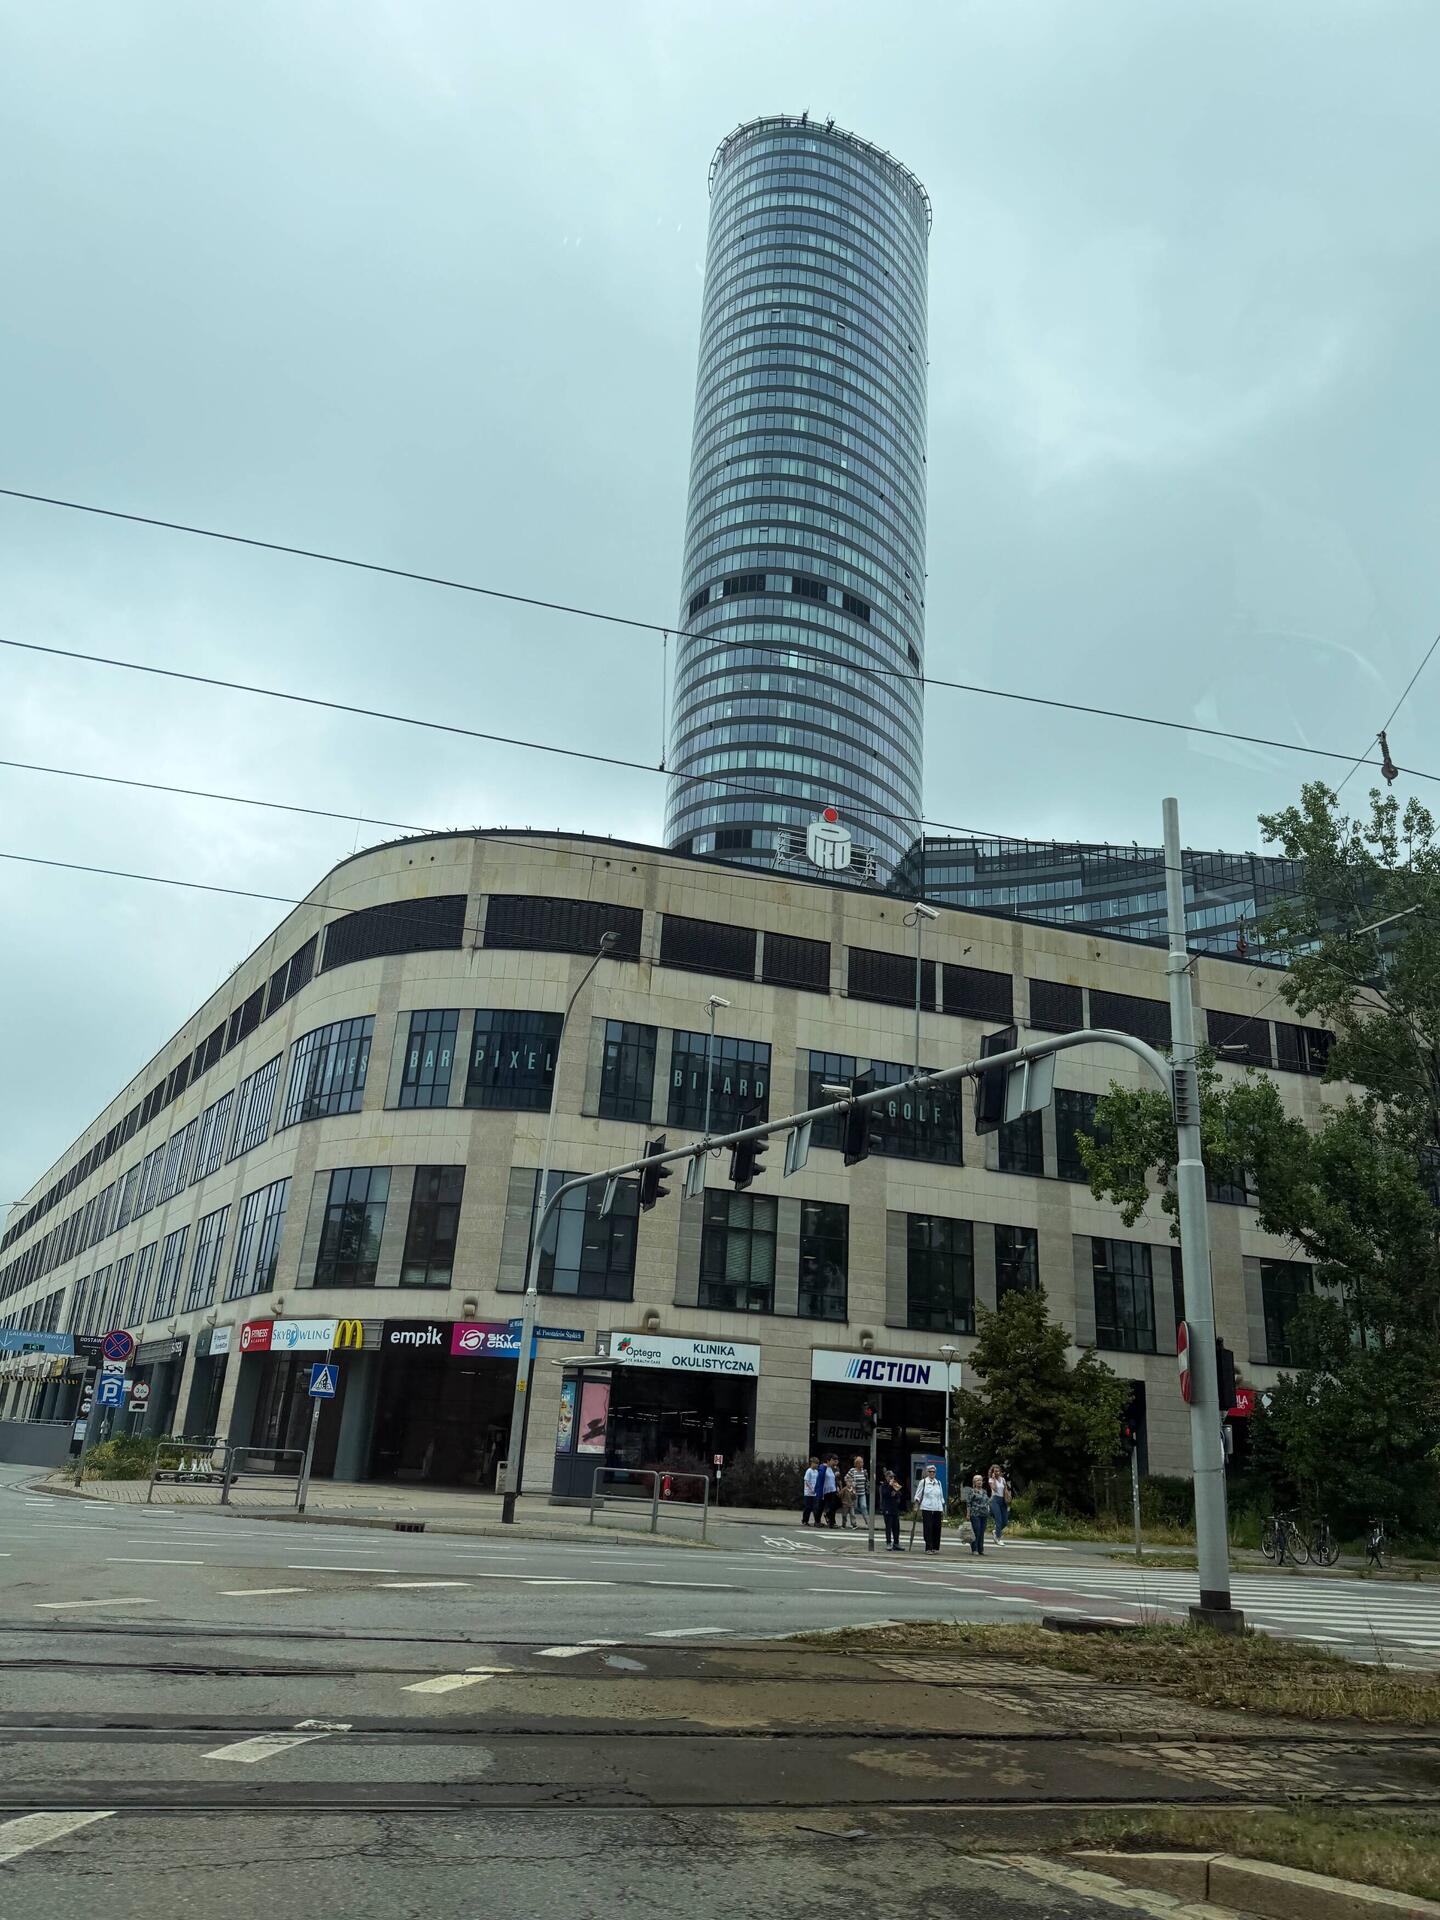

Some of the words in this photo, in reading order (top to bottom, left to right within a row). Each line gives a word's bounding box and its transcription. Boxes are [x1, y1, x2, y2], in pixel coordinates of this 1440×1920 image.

[410, 1049, 451, 1068] BAR
[474, 1050, 552, 1071] PIXEL
[674, 1069, 763, 1098] BIARD
[889, 1101, 941, 1124] GOLF
[390, 1326, 442, 1347] empik
[487, 1333, 514, 1342] SKY
[626, 1346, 661, 1359] Optegra
[693, 1343, 735, 1356] KLINIKA
[672, 1355, 754, 1372] OKULISTYCZNA
[857, 1360, 930, 1384] ACTION
